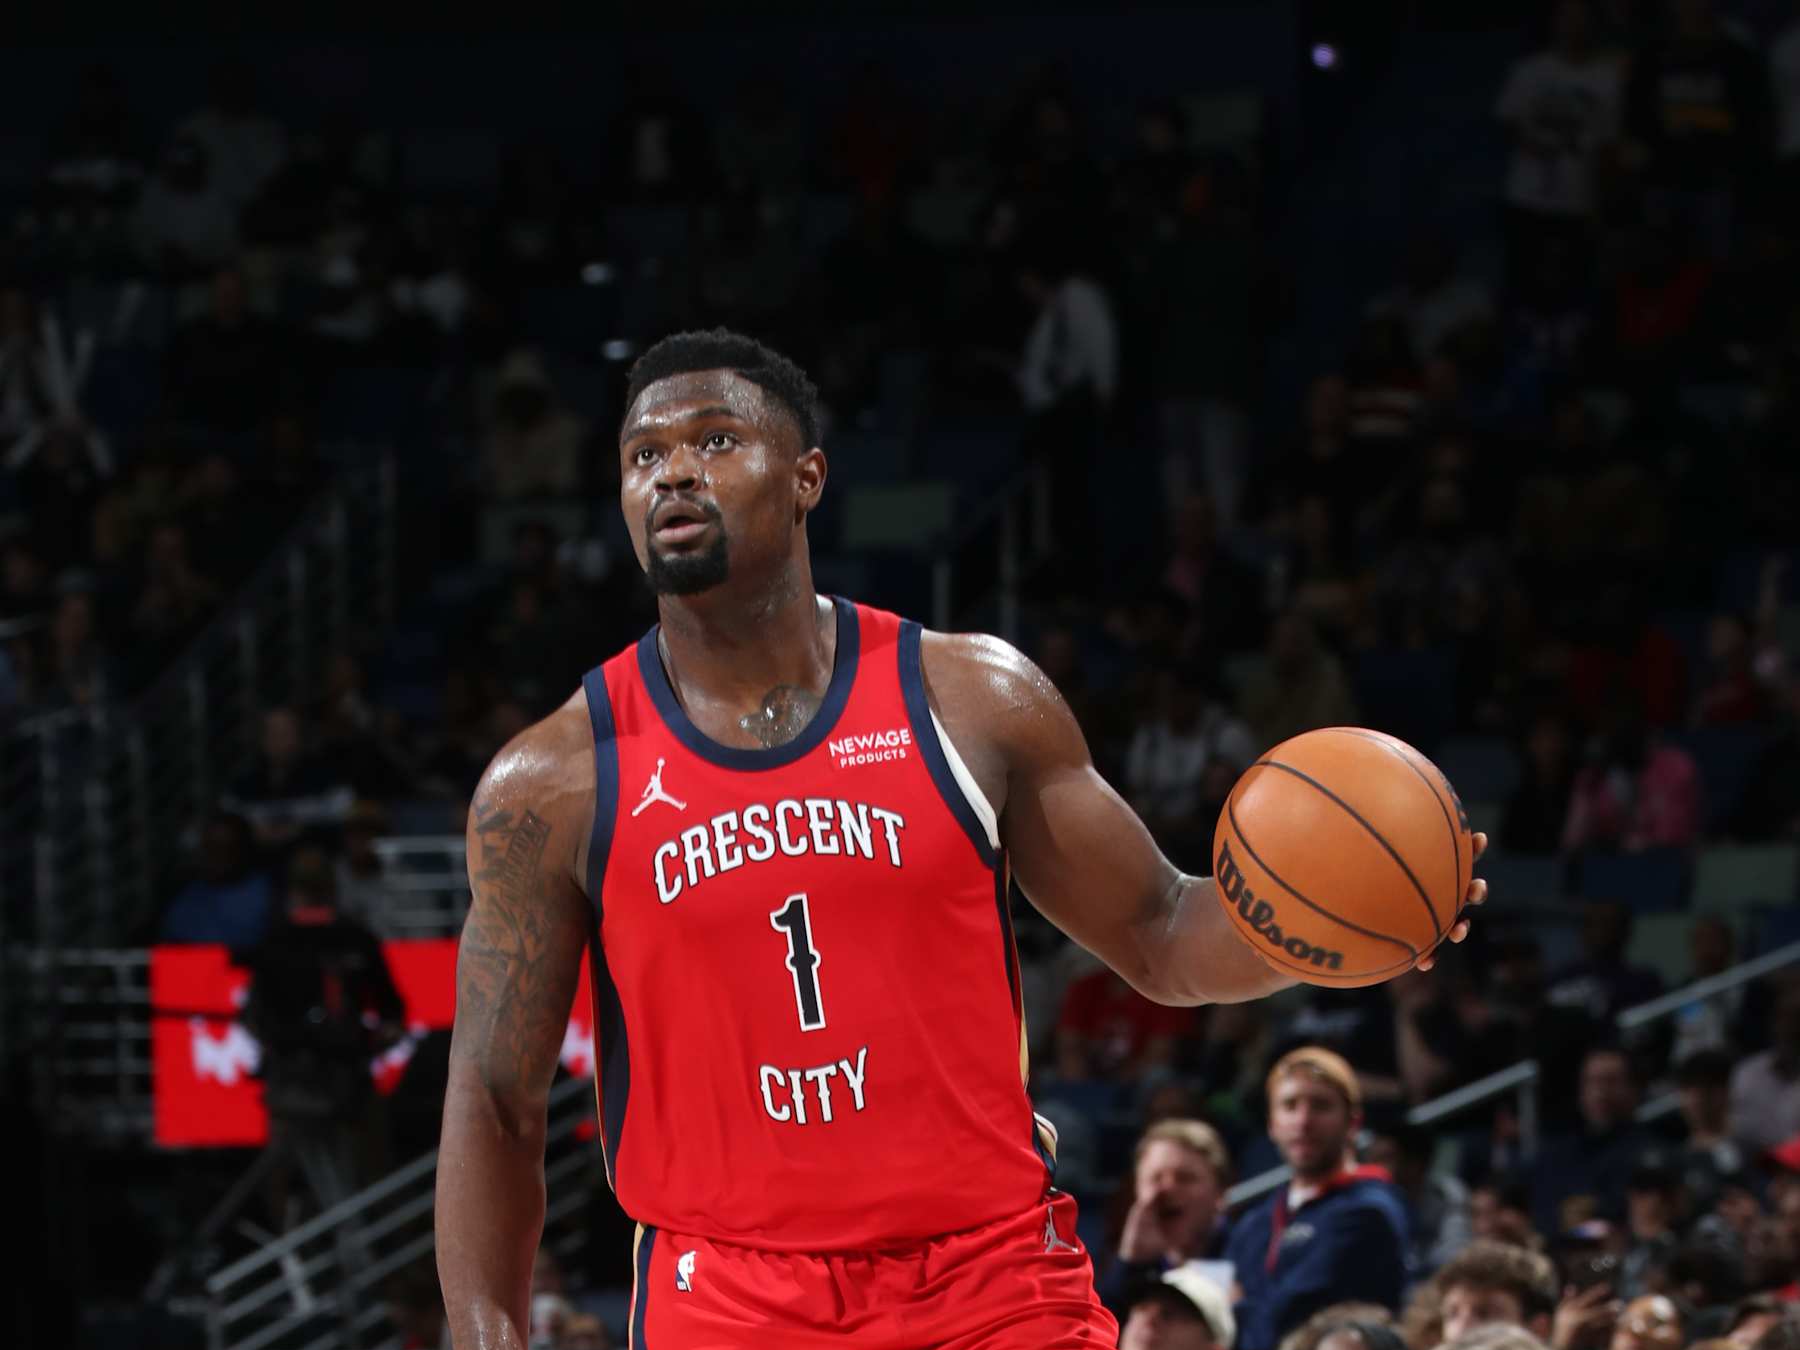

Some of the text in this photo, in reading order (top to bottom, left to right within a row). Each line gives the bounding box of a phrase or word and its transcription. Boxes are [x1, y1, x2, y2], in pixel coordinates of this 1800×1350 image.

[828, 728, 912, 757] NEWAGE
[840, 748, 907, 768] PRODUCTS
[653, 799, 905, 904] CRESCENT
[1216, 837, 1345, 971] Wilson
[769, 893, 827, 1032] 1
[759, 1046, 869, 1125] CITY
